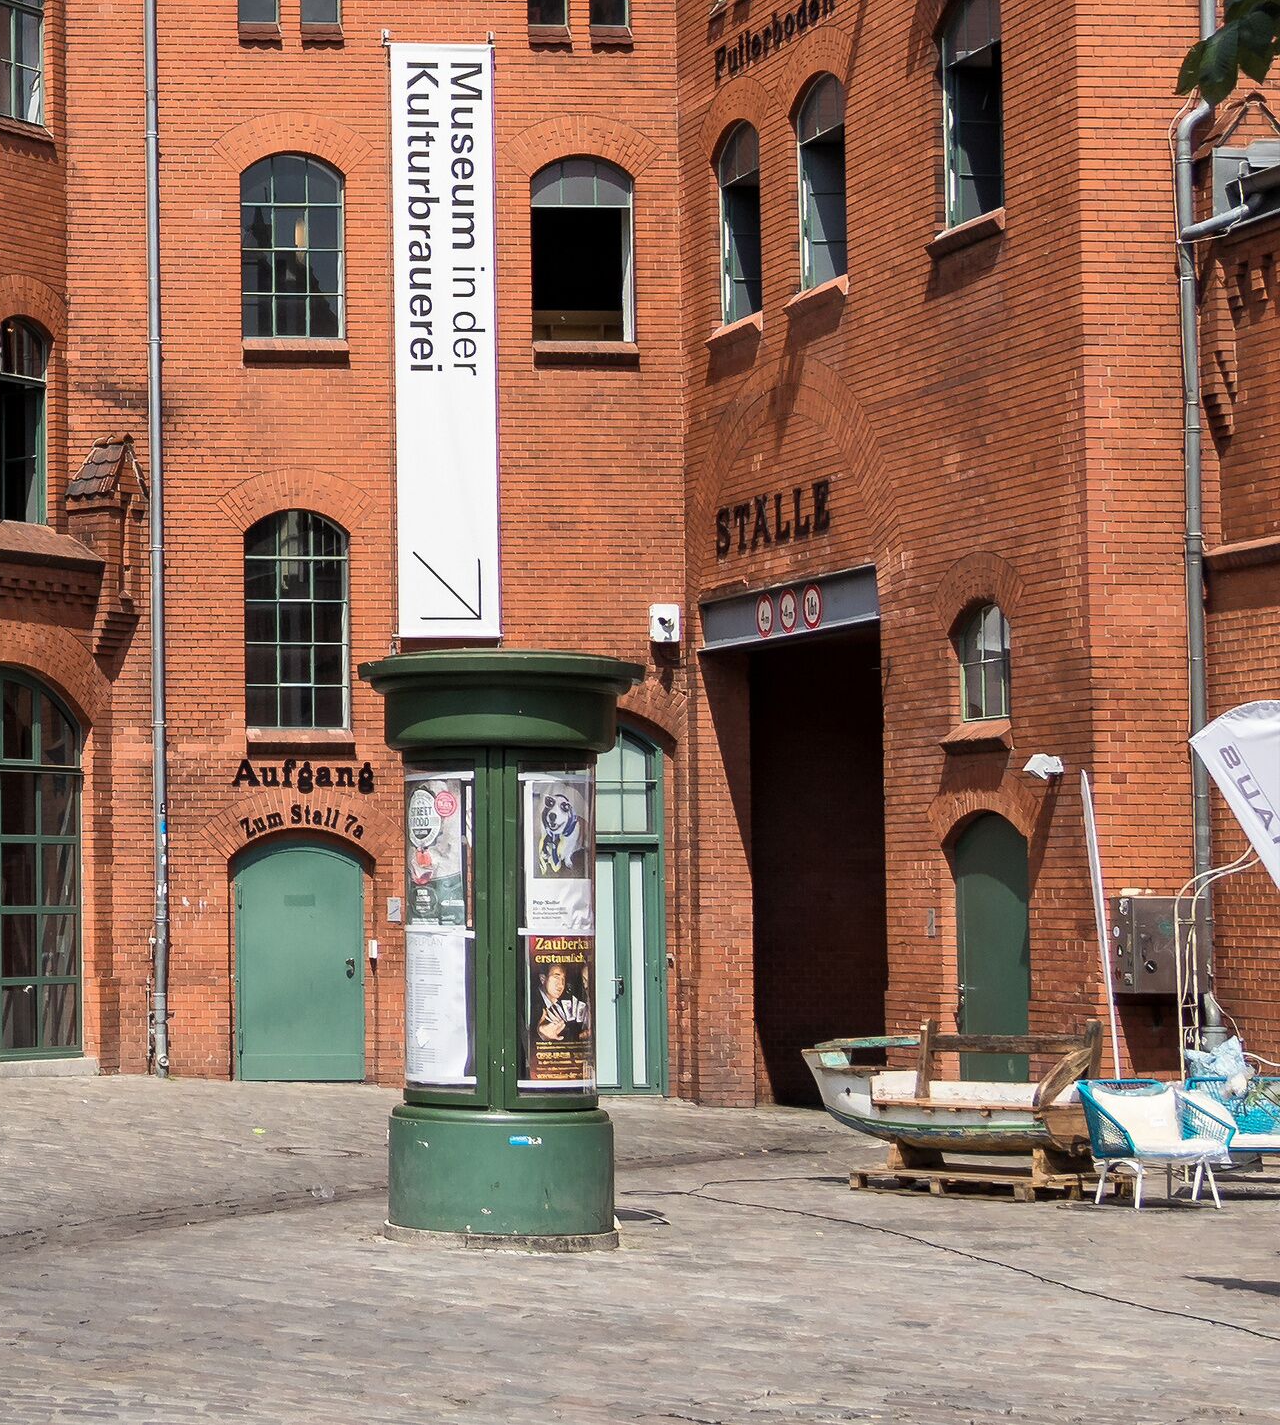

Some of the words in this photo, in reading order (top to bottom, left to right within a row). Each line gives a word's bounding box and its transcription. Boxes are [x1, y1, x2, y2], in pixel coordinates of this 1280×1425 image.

[450, 62, 483, 250] Museum
[406, 62, 443, 372] Kulturbrauerei
[452, 266, 485, 298] in
[453, 311, 486, 376] der
[715, 479, 831, 560] STÄLLE
[232, 758, 374, 794] Aufgang
[240, 812, 285, 839] Zum
[291, 804, 340, 829] Stall
[344, 814, 364, 839] 7a
